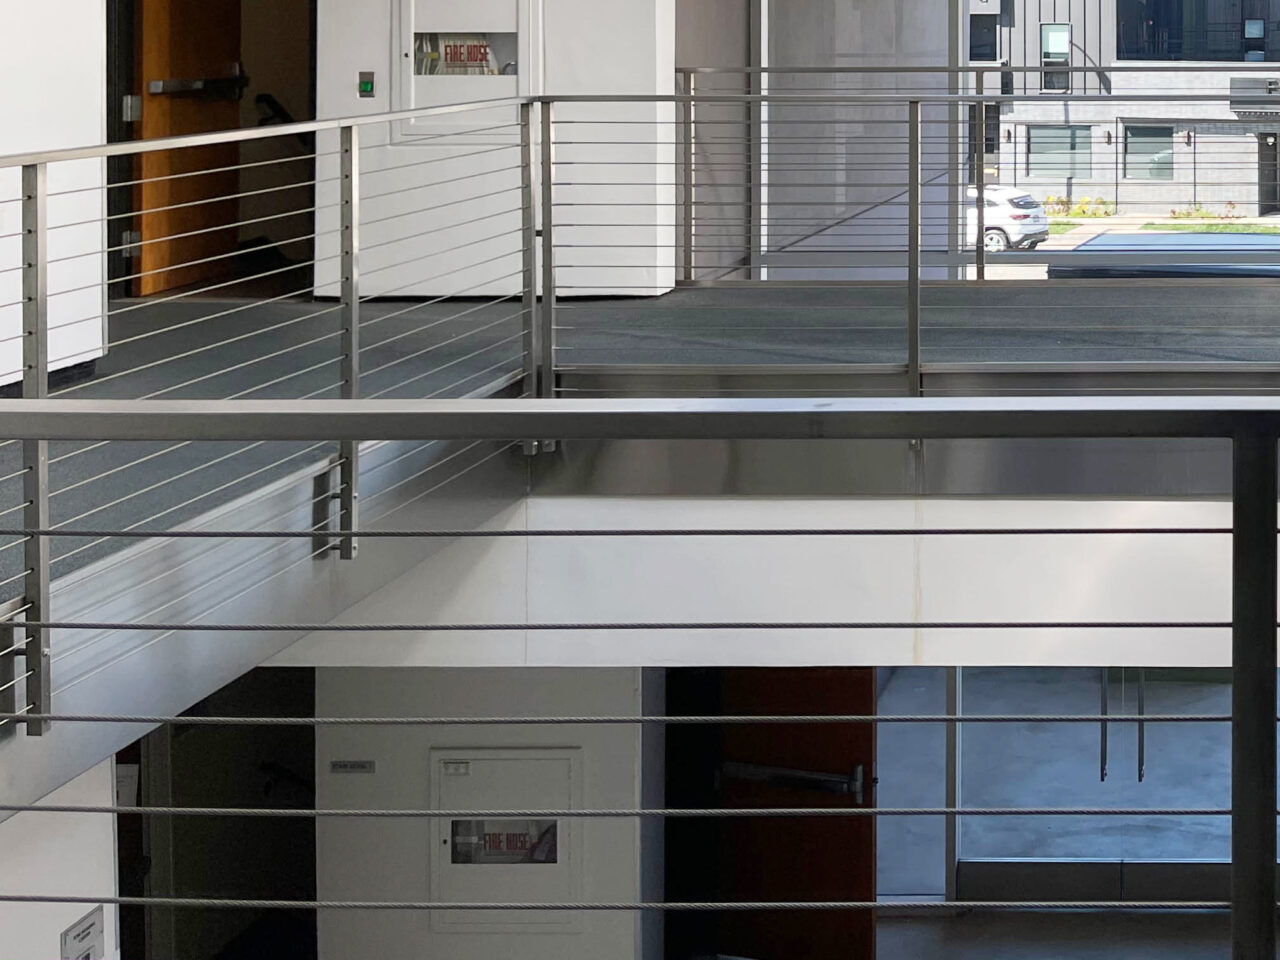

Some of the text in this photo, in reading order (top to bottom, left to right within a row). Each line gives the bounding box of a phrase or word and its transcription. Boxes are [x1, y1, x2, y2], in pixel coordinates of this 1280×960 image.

[444, 44, 489, 62] FIRE HOSE
[483, 832, 529, 850] FIRE HOSE
